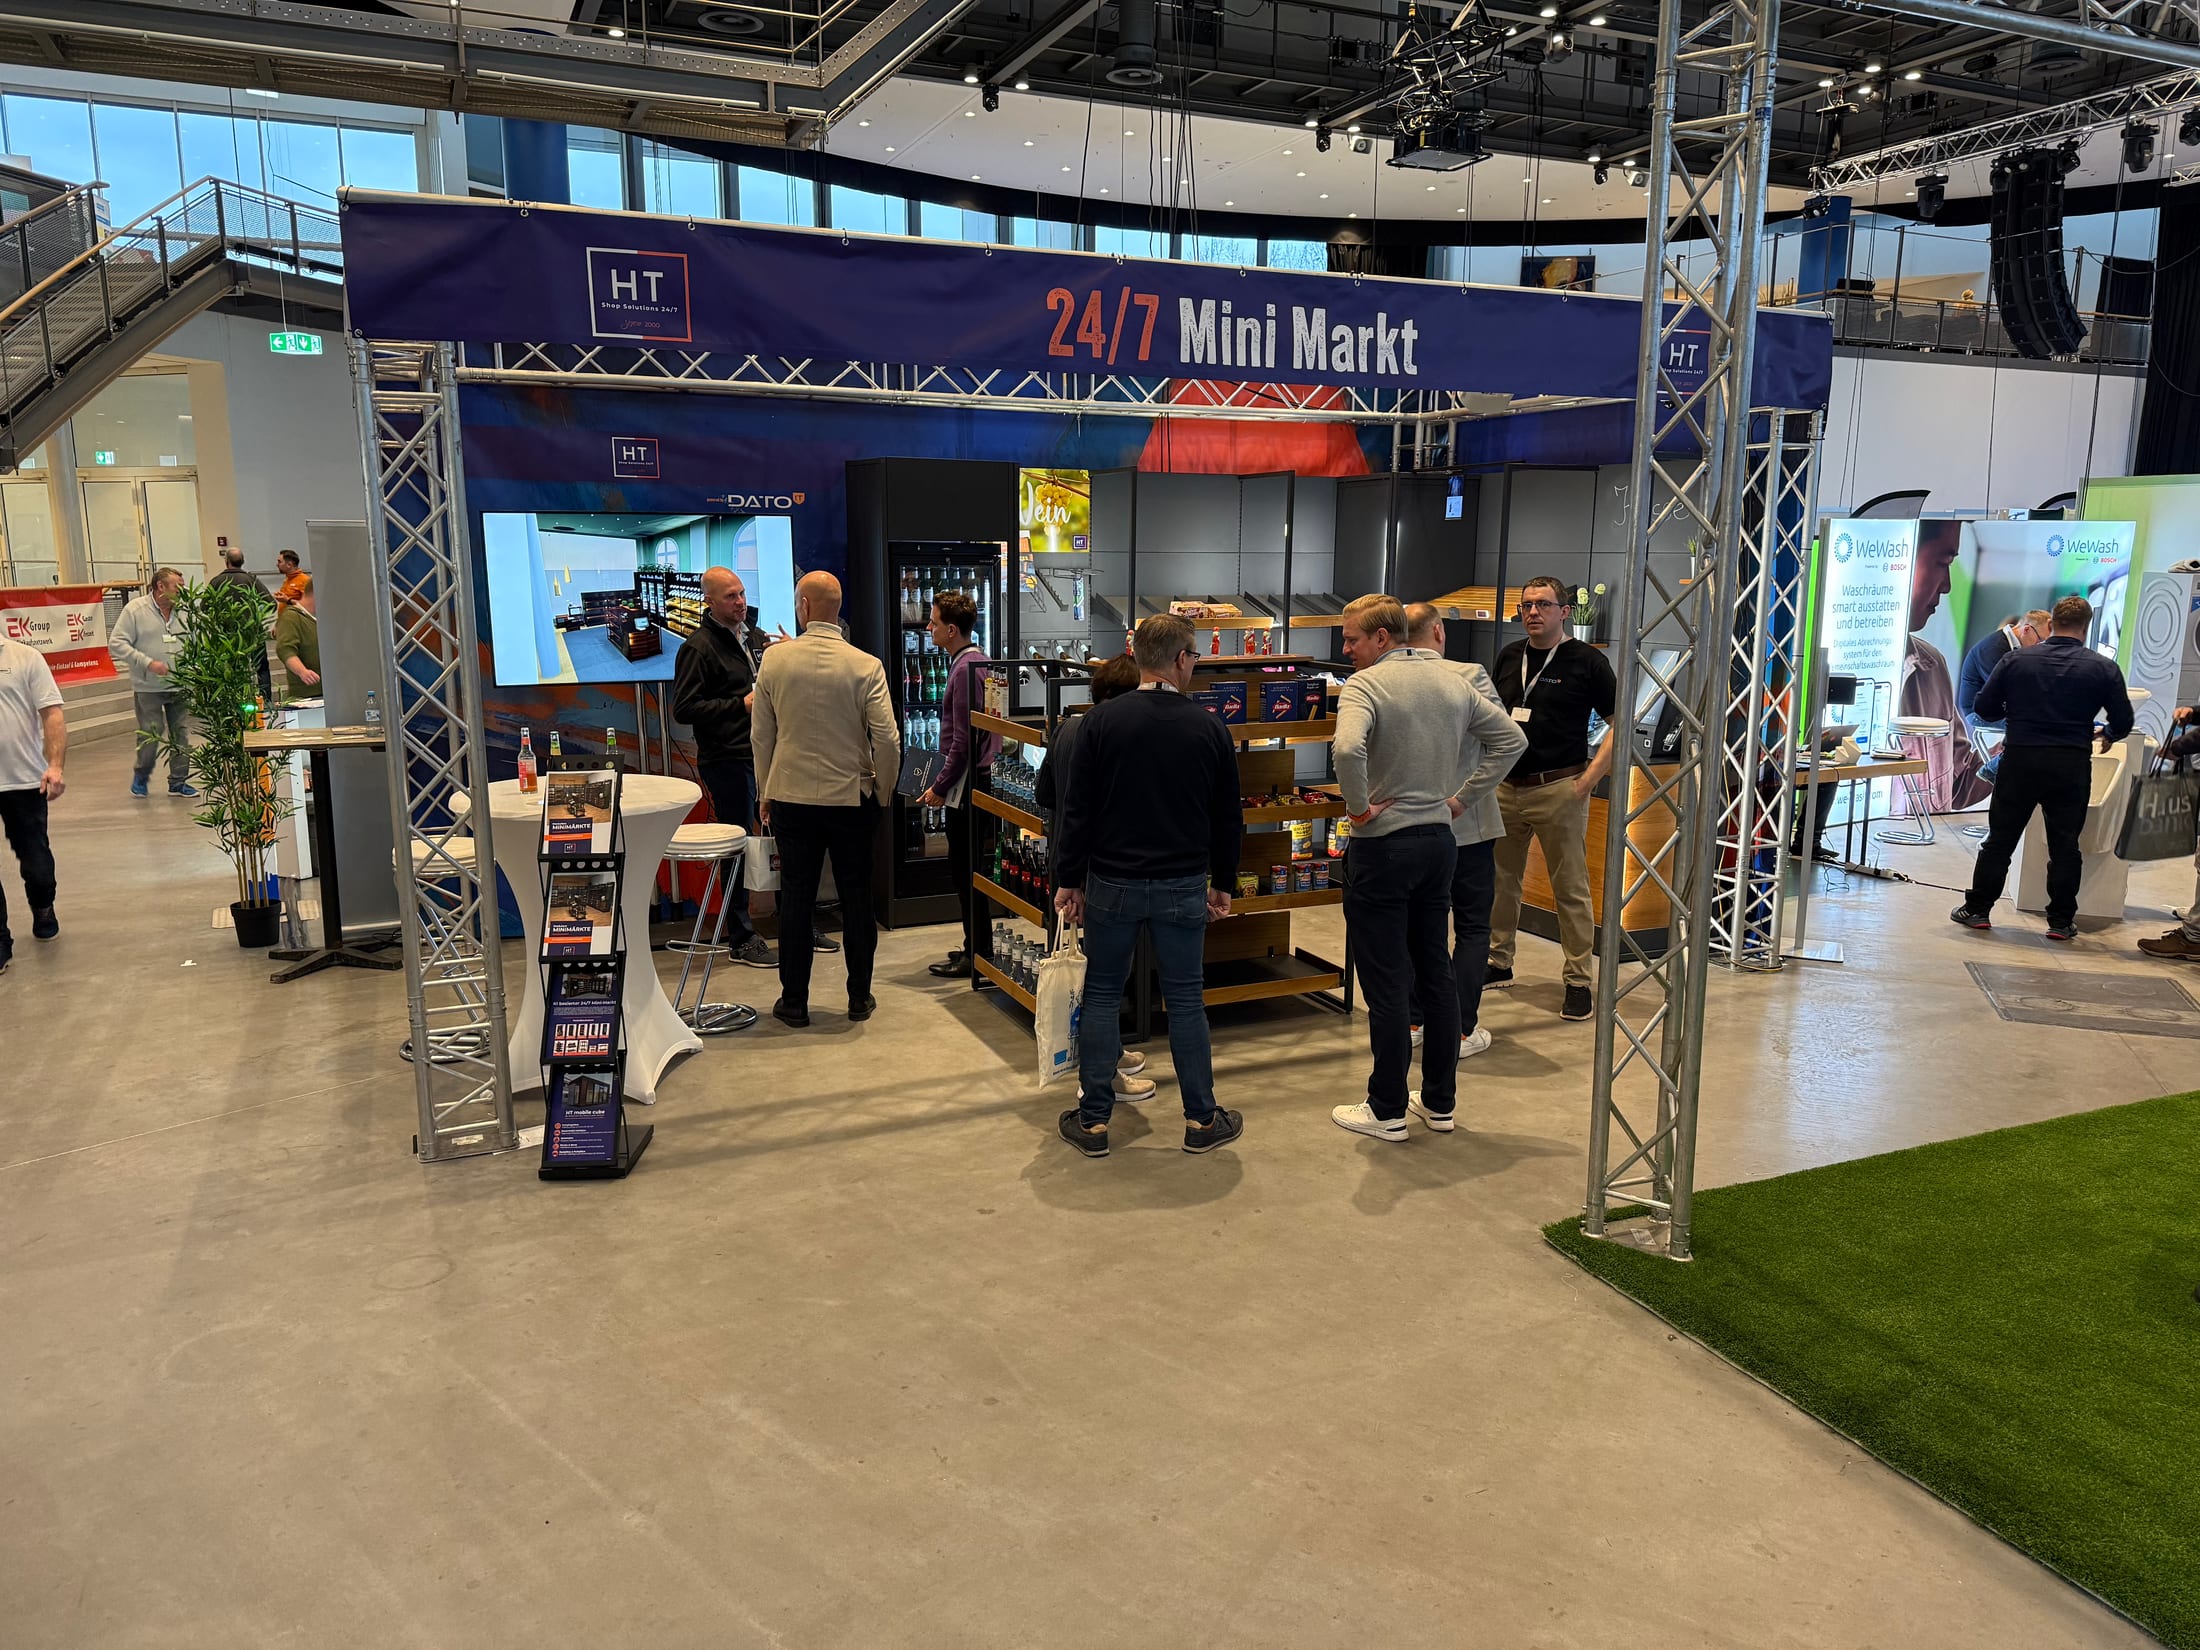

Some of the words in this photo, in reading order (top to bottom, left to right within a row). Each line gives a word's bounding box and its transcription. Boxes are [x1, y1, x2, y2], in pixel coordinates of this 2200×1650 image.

[611, 269, 664, 302] HT
[601, 302, 621, 310] Shop
[622, 303, 659, 312] Solutions
[1046, 286, 1160, 366] 24/7
[1179, 297, 1276, 369] Mini
[1292, 306, 1419, 376] Markt
[1669, 343, 1699, 367] HT
[623, 446, 647, 461] HT
[727, 494, 793, 509] DATO
[1856, 538, 1909, 558] WeWash
[2067, 538, 2119, 554] WeWash
[1890, 563, 1907, 571] BOSCH
[1842, 584, 1894, 596] Waschräume
[1832, 602, 1856, 613] smart
[1857, 601, 1900, 612] ausstatten
[6, 616, 32, 637] EK
[30, 621, 51, 632] Group
[1836, 616, 1853, 629] und
[1854, 616, 1894, 629] betreiben
[1843, 649, 1861, 660] system
[552, 925, 591, 933] MINIMÄRKTE
